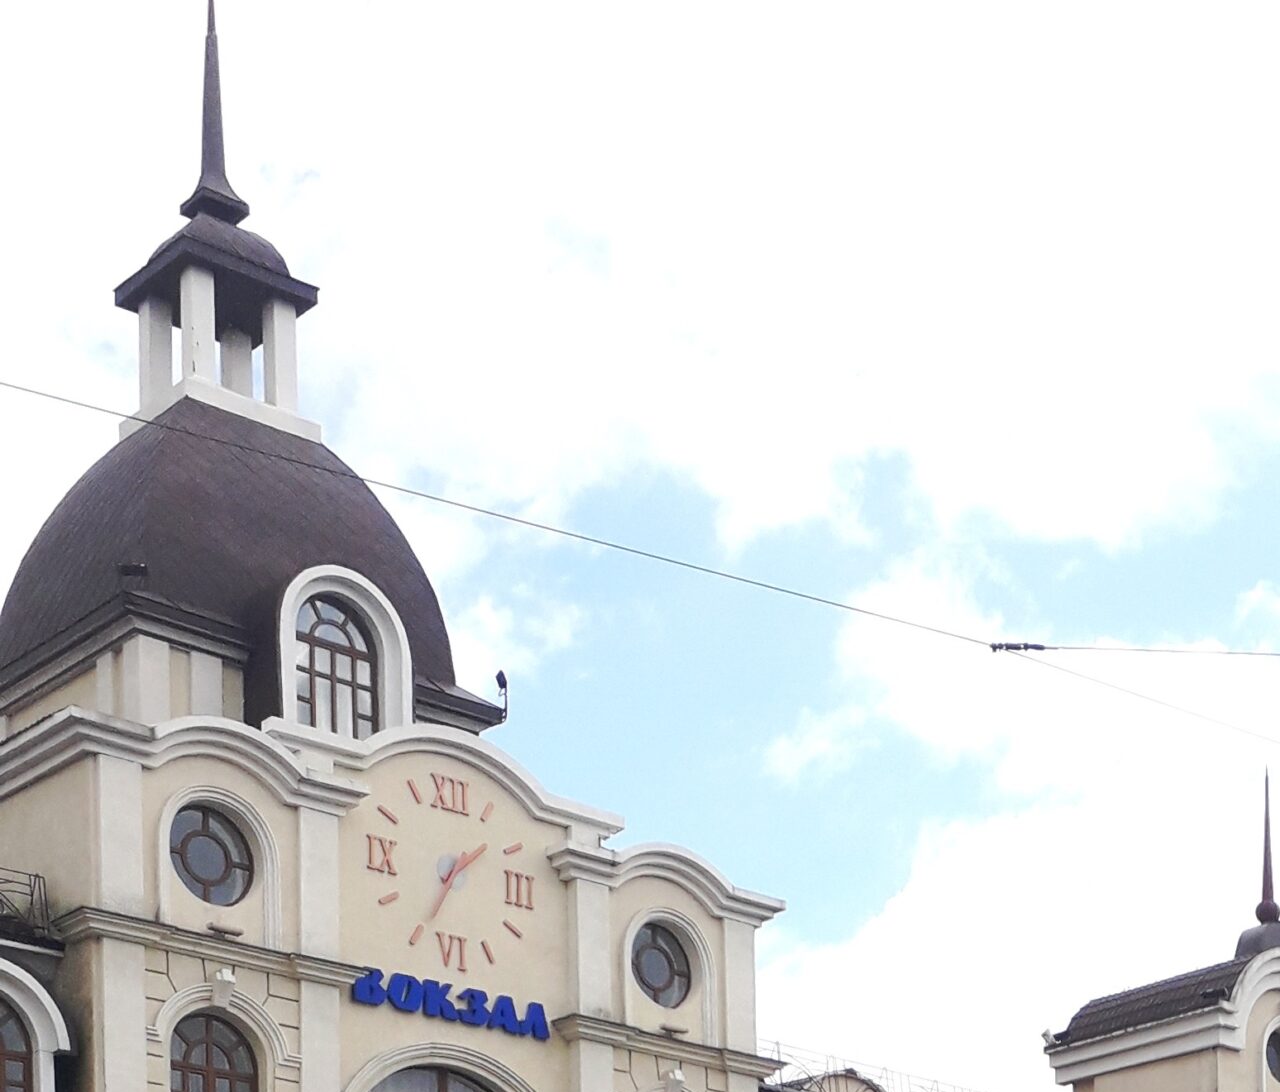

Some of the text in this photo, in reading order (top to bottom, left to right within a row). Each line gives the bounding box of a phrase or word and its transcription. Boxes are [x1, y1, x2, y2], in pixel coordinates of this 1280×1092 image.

[431, 774, 469, 815] XII
[366, 834, 398, 875] IX
[504, 870, 535, 909] III
[436, 932, 467, 971] VI
[352, 966, 550, 1040] ВОКЗАЛ
